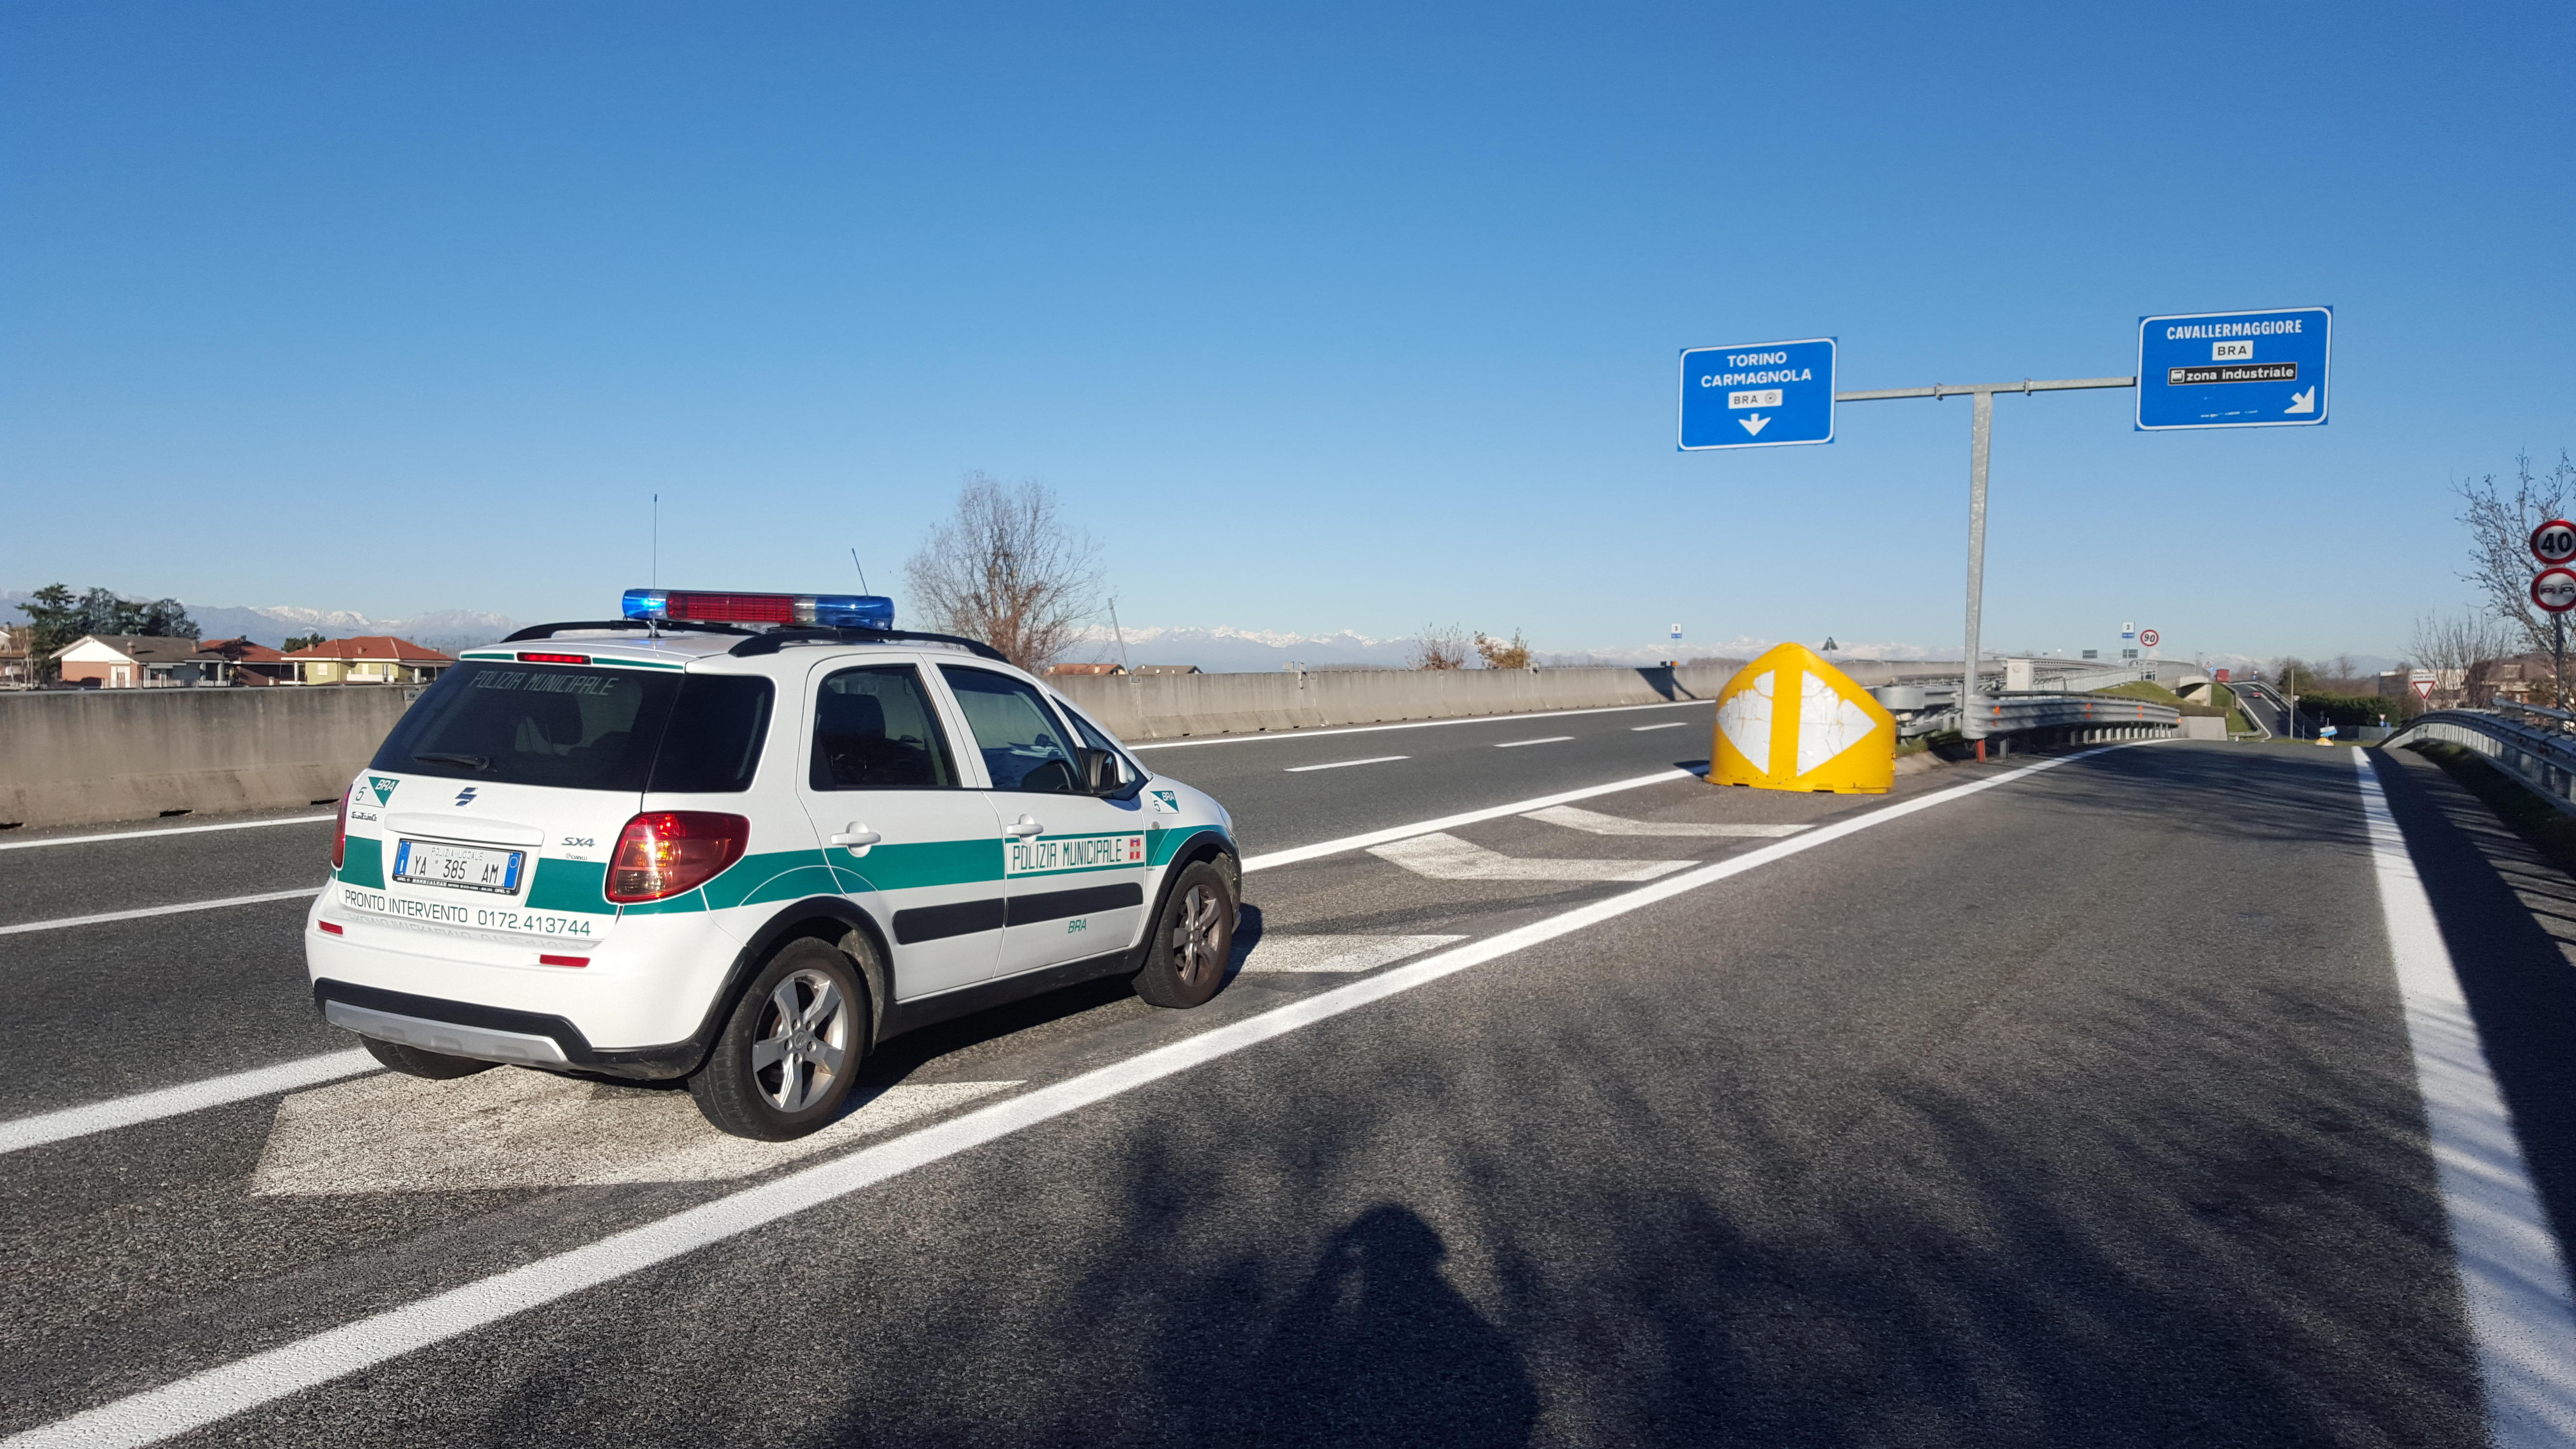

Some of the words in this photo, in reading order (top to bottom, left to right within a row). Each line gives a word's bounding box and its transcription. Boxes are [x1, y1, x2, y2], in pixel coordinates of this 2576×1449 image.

[2167, 320, 2302, 339] CAVALLERMAGGIORE
[2218, 346, 2247, 356] BRA
[1727, 352, 1787, 367] TORINO
[1701, 369, 1811, 387] CARMAGNOLA
[2187, 371, 2217, 381] zona
[2222, 367, 2294, 380] industriale
[1734, 395, 1758, 405] BRA
[2541, 532, 2572, 553] 40
[2144, 634, 2155, 643] 90
[469, 670, 527, 690] POLIZIA
[523, 673, 619, 695] MUNICIPALE
[375, 779, 396, 792] BRA
[355, 787, 367, 801] 5
[1161, 792, 1175, 801] BRA
[1154, 800, 1160, 812] 5
[562, 837, 596, 847] SX4
[432, 847, 454, 857] POLIZIA
[459, 851, 484, 861] LOCALE
[1013, 842, 1056, 871] POLIZIA
[1063, 838, 1122, 867] MUNICIPALE
[414, 855, 427, 876] YA
[443, 859, 467, 879] 385
[481, 863, 499, 884] AM
[345, 889, 385, 911] PRONTO
[389, 898, 467, 922] INTERVENTO
[478, 910, 591, 936] 0172.413744
[1068, 918, 1086, 934] BRA
